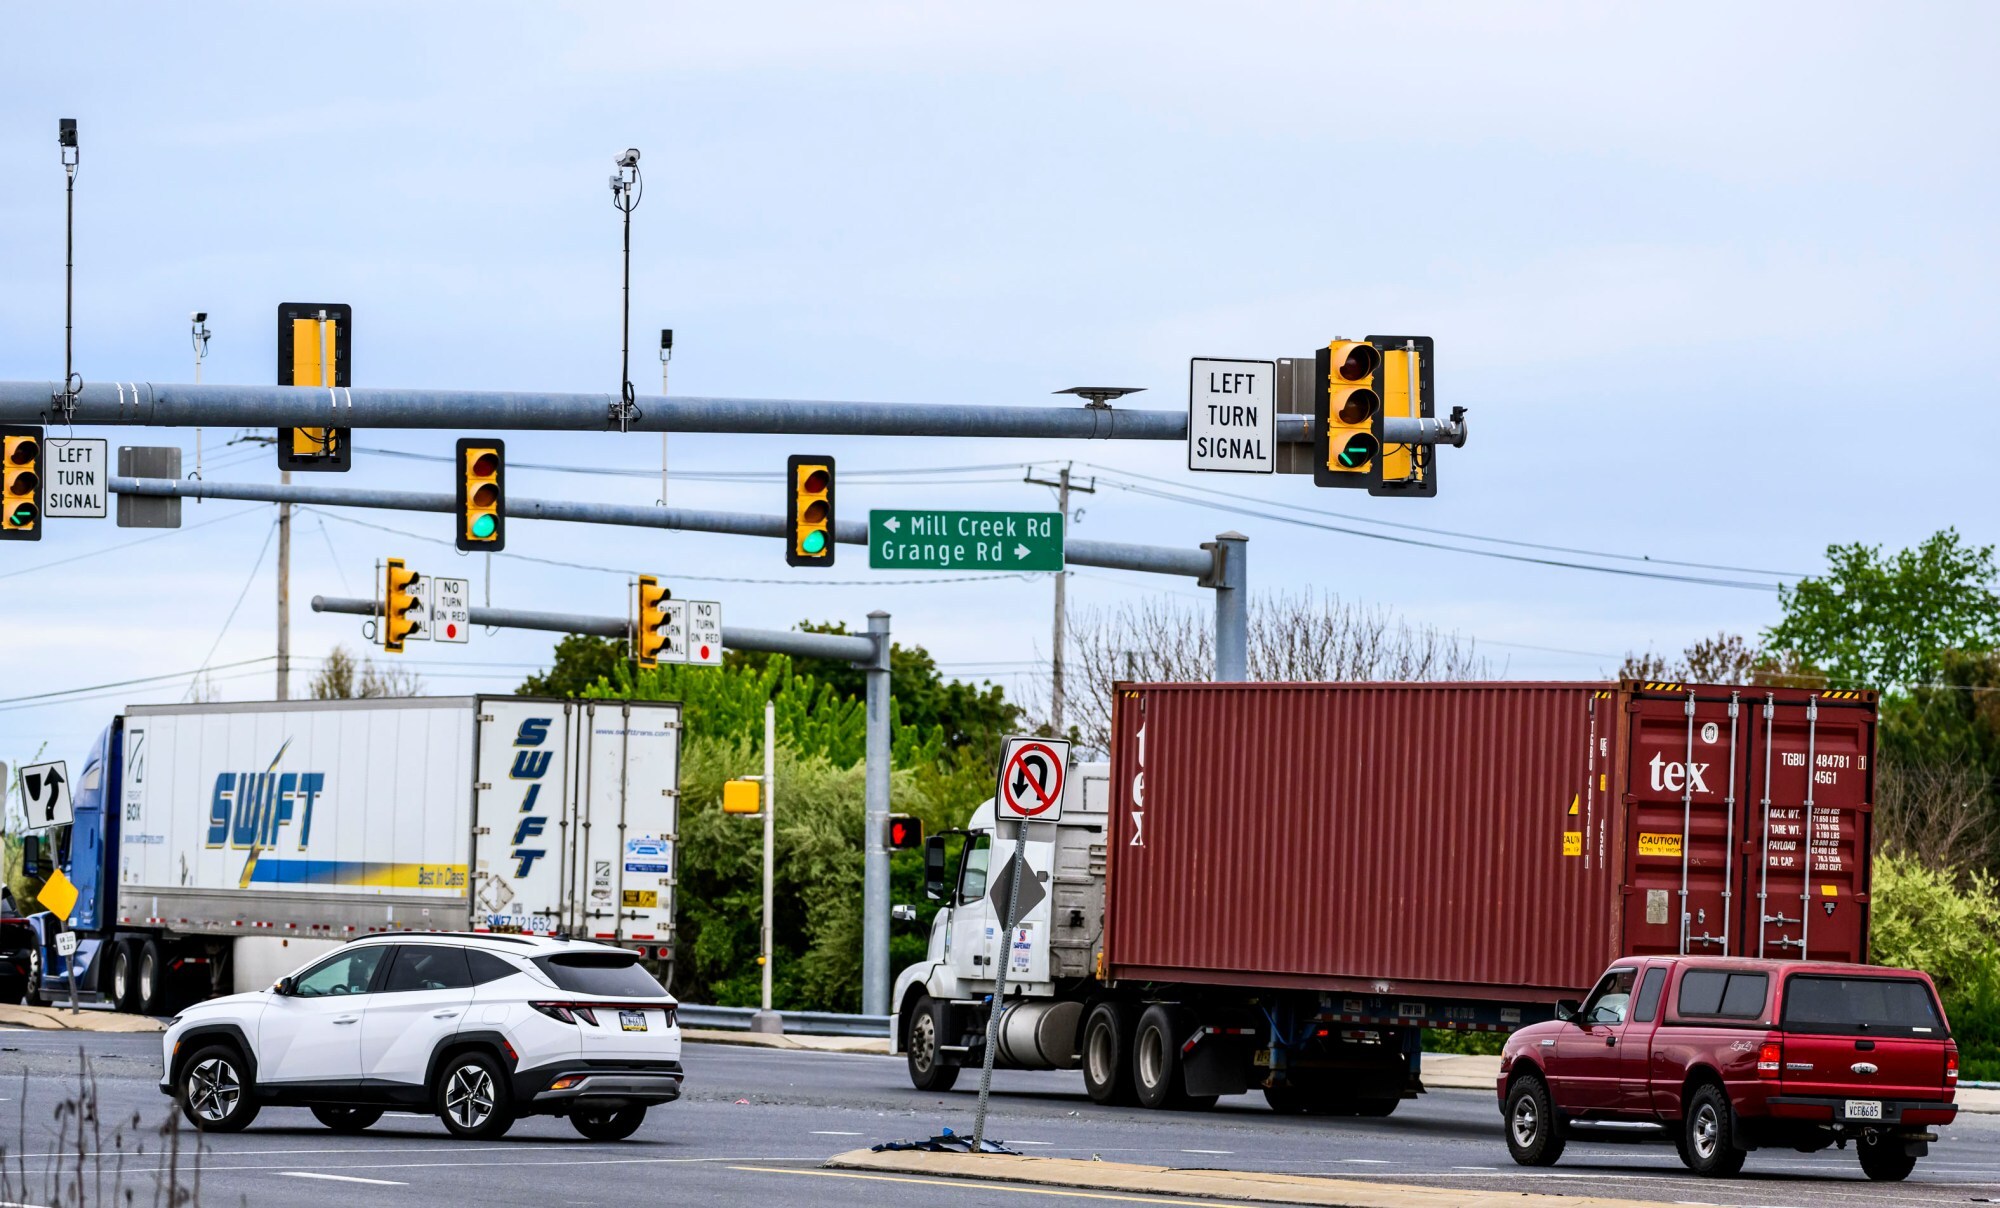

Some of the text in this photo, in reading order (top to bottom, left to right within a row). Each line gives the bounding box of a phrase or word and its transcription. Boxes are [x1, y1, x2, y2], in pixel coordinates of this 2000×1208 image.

[1210, 372, 1256, 394] LEFT
[1207, 405, 1258, 427] TURN
[59, 448, 92, 462] LEFT
[1196, 437, 1267, 460] SIGNAL
[57, 471, 94, 486] TURN
[50, 493, 102, 508] SIGNAL
[911, 515, 1051, 538] Mill Creek Rd
[882, 540, 1002, 566] Grange Rd
[444, 581, 459, 594] NO
[442, 596, 462, 608] TURN
[436, 610, 466, 622] ON RED
[698, 604, 712, 616] NO
[696, 620, 714, 630] TURN
[690, 633, 720, 644] ON RED
[595, 728, 671, 738] www.swfttrans.com
[1782, 752, 1806, 766] TGBU
[1816, 754, 1850, 768] 484781
[1648, 750, 1710, 793] tex
[1814, 771, 1837, 784] 45G1
[509, 717, 554, 878] SWIFT
[205, 773, 325, 851] SWIFT
[1770, 808, 1800, 820] MAX. WT.
[1770, 824, 1802, 835] TARE WT.
[1640, 836, 1680, 846] CAUTION
[1768, 840, 1796, 850] PAYLOAD
[1780, 856, 1794, 866] CAP.
